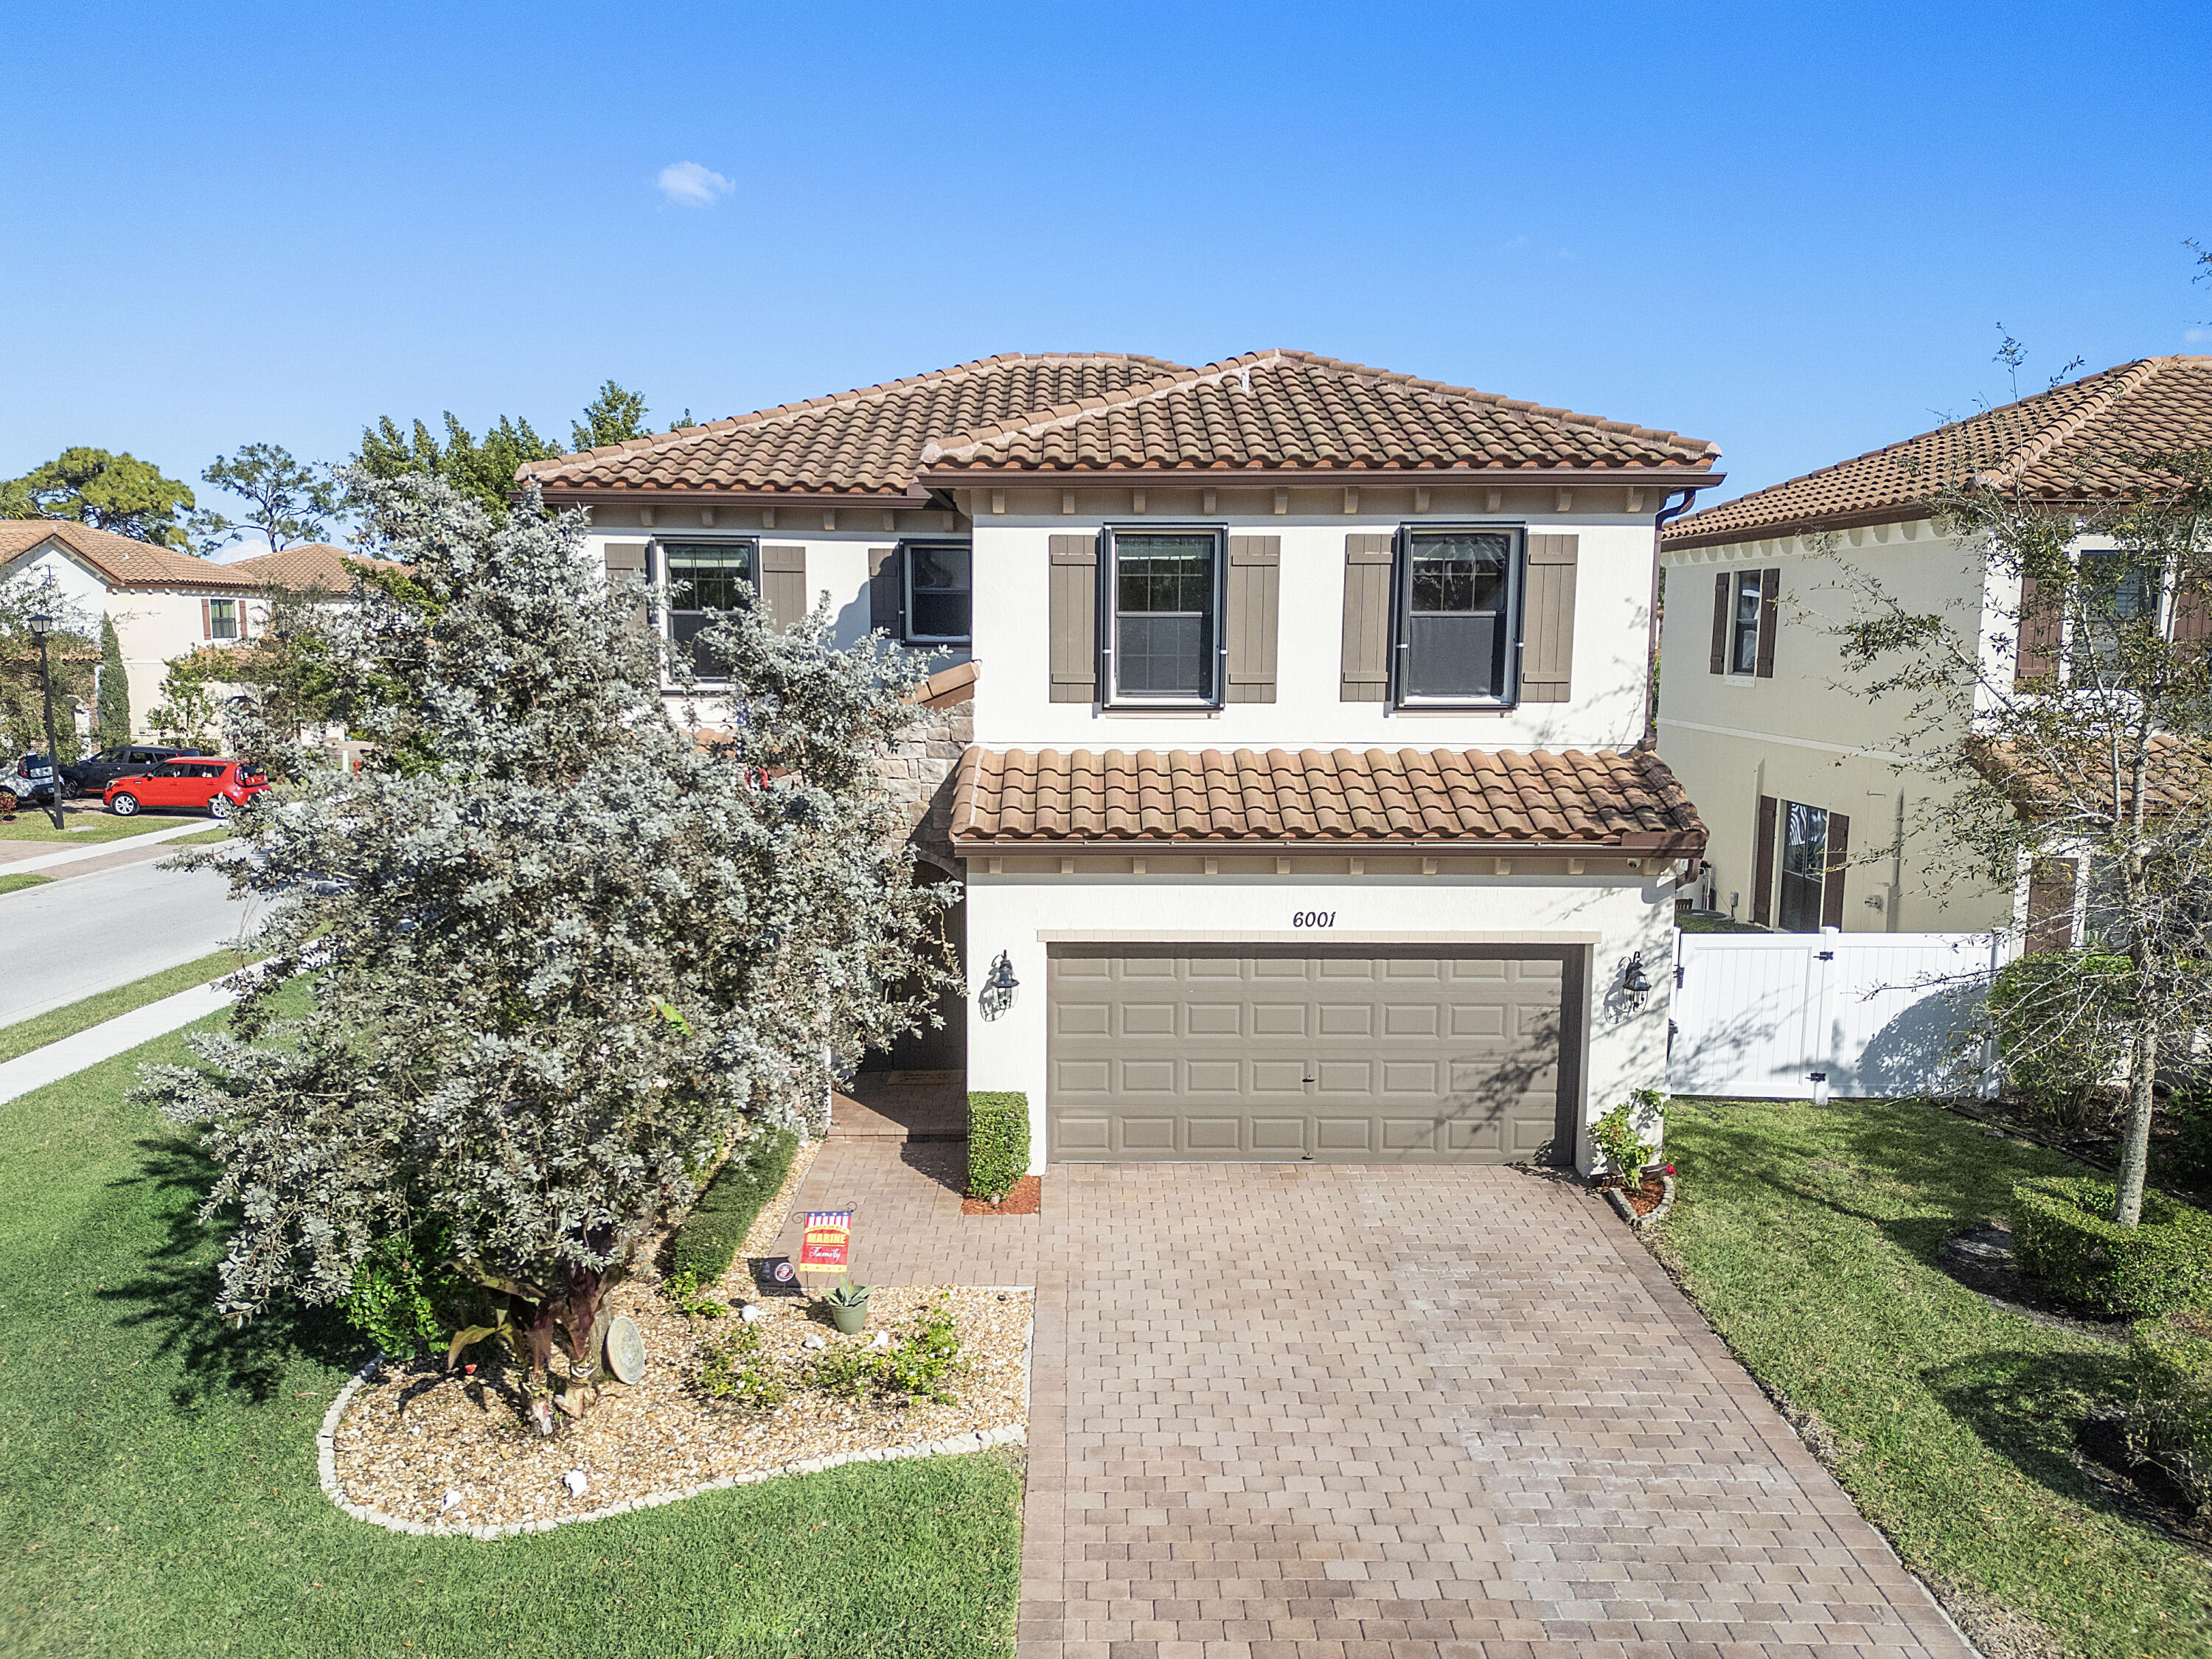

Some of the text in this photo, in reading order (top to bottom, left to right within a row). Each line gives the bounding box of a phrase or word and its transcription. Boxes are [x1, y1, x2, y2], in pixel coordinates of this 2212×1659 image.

[1293, 911, 1336, 928] 6001
[807, 1233, 846, 1244] MARINE
[809, 1246, 841, 1264] Family
